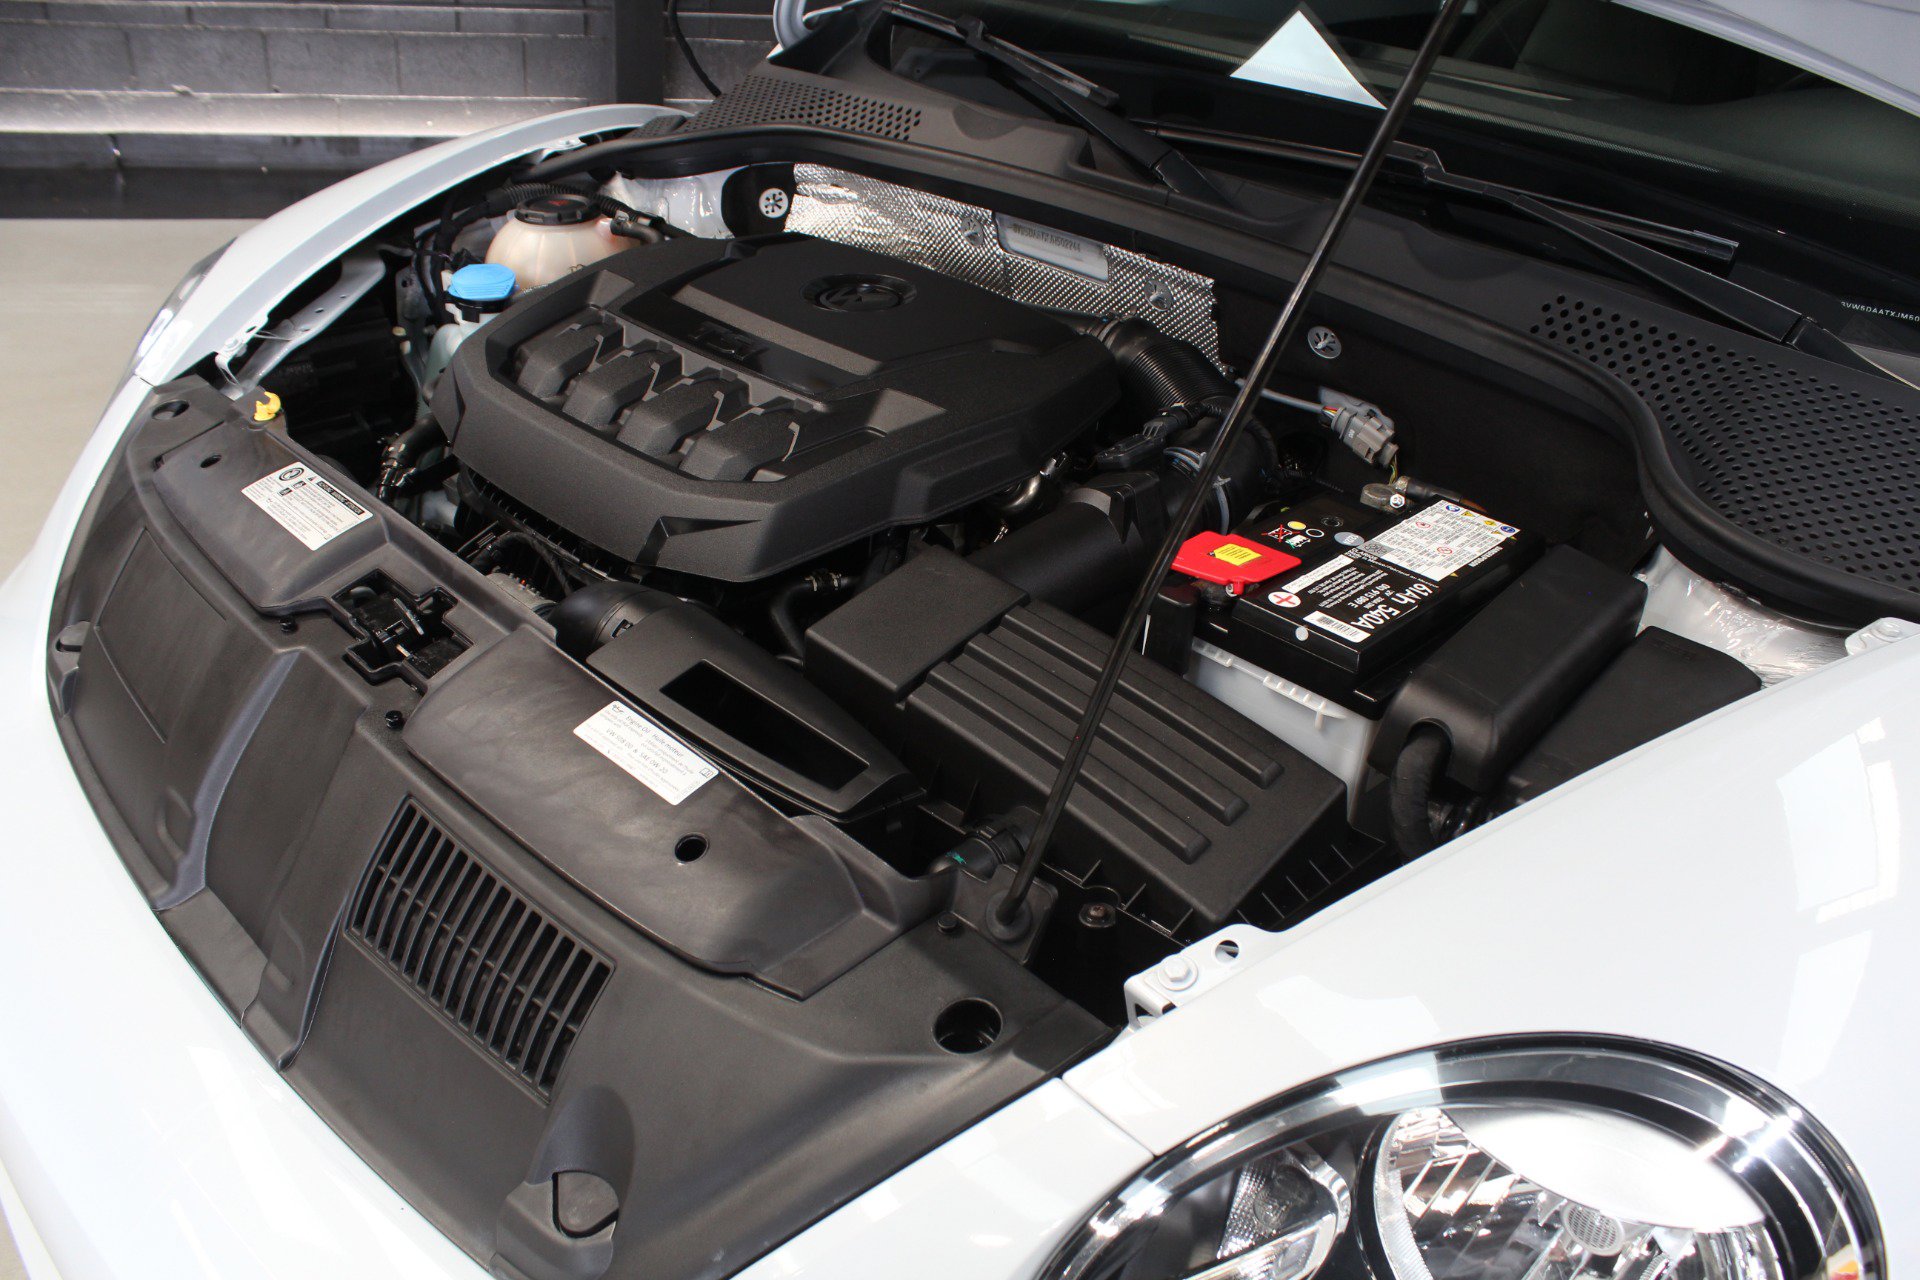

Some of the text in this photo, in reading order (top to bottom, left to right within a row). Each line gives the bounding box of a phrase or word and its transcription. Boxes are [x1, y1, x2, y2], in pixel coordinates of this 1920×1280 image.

[1391, 583, 1434, 604] 61Ah
[1351, 604, 1401, 630] 540A
[626, 715, 643, 729] Engine
[652, 734, 667, 745] Huile
[665, 743, 684, 757] moteur
